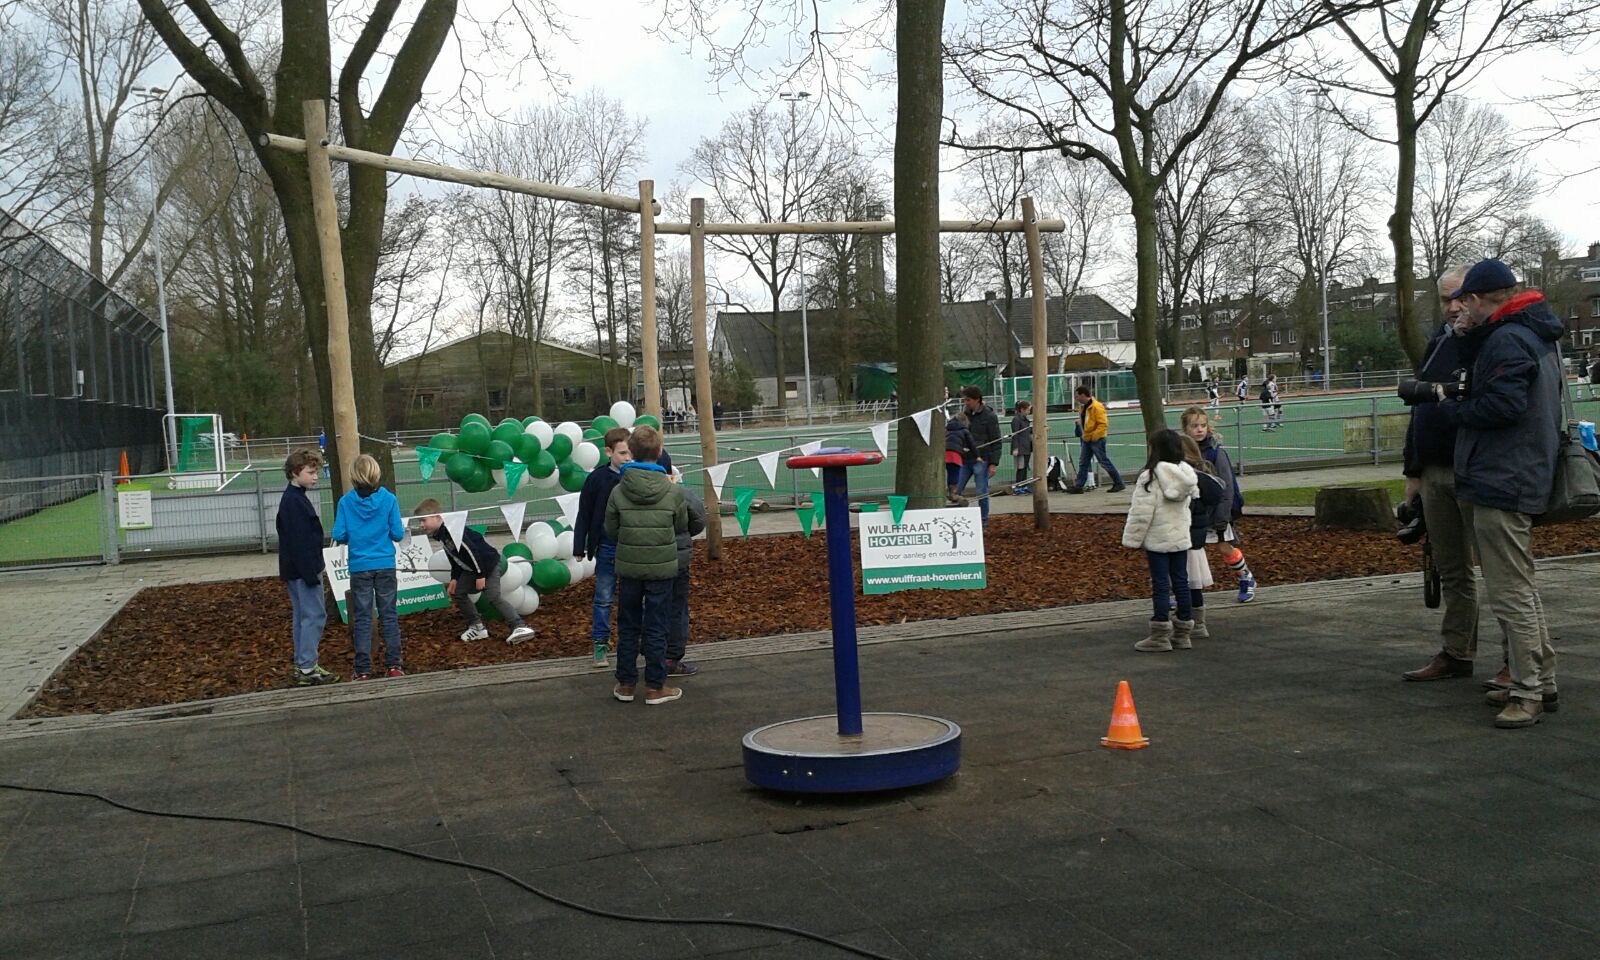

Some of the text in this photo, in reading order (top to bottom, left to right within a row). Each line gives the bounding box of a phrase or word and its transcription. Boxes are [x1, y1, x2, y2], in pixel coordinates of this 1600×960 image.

[868, 523, 930, 534] WULFFRAAT
[869, 535, 930, 547] HOVENIER
[903, 552, 927, 560] aanleg
[939, 549, 977, 557] onderhoud
[867, 571, 982, 584] www.wulffraat-hovenier.nl
